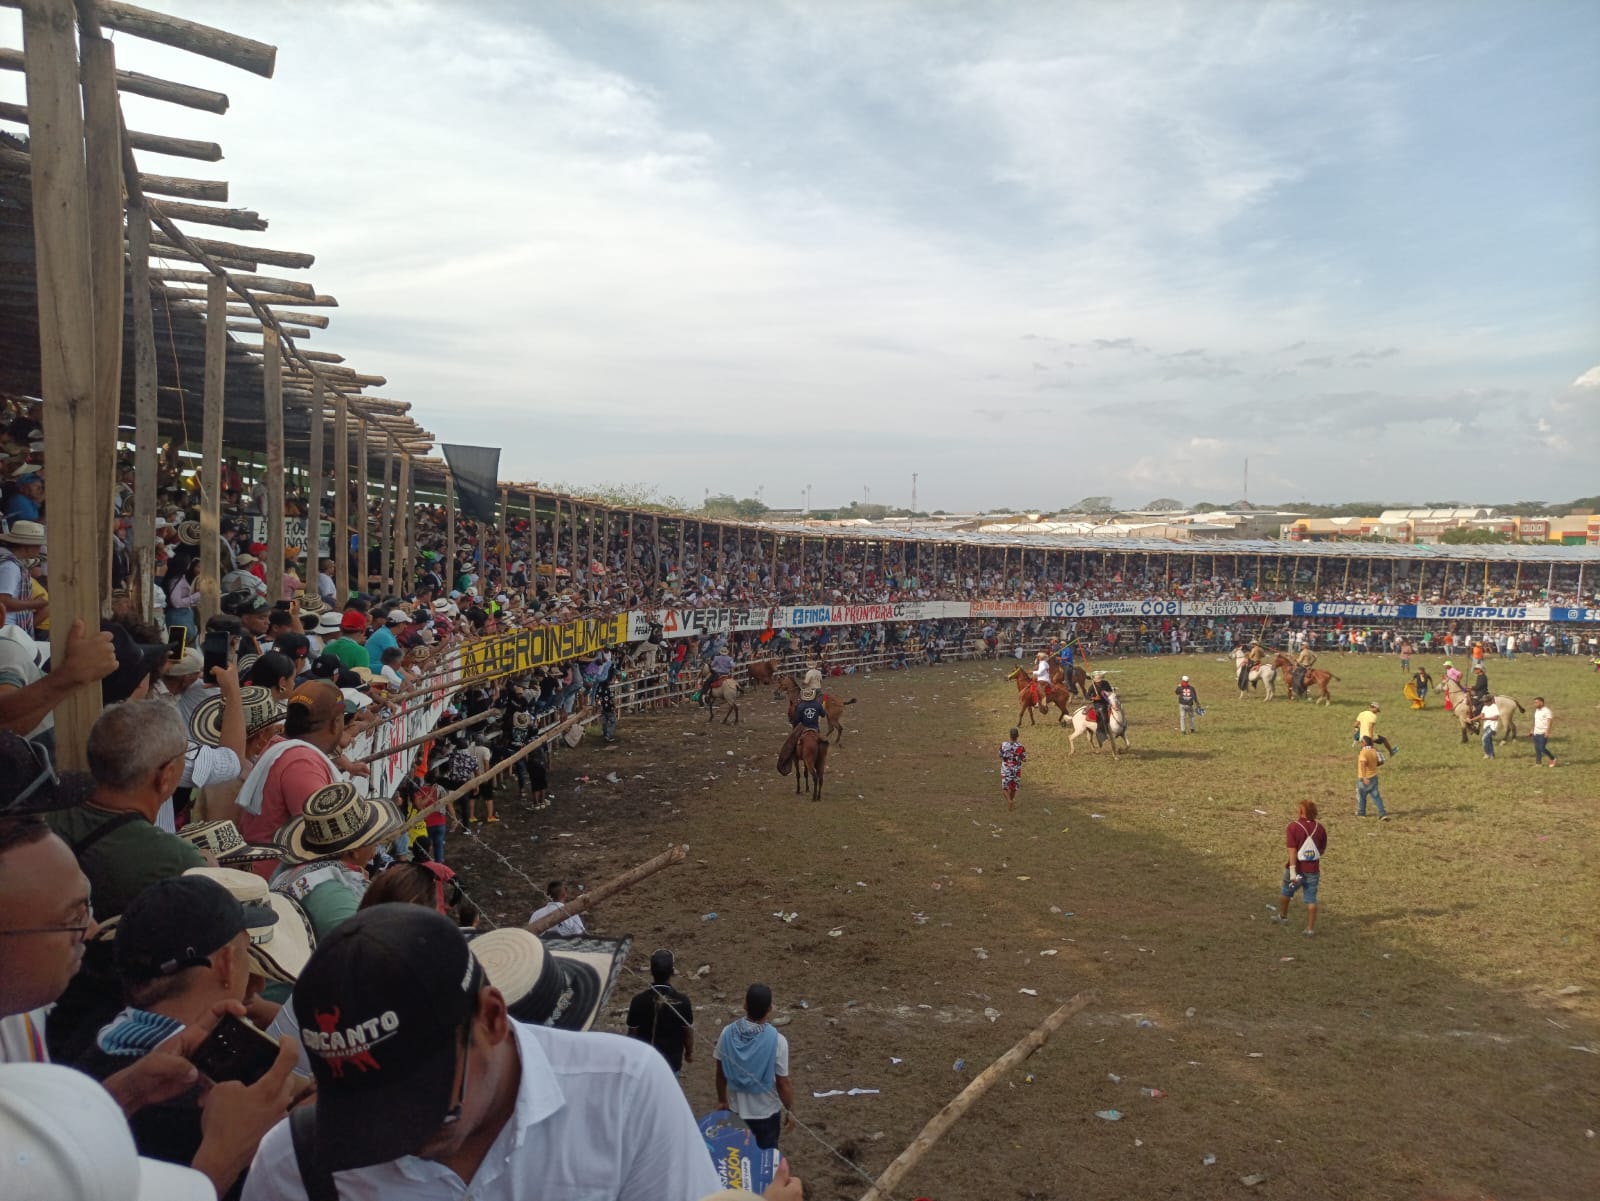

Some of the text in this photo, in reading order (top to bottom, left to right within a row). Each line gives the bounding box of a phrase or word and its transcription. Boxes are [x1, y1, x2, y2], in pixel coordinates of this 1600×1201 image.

[805, 606, 830, 624] FINCA
[832, 607, 842, 622] LA
[845, 604, 893, 623] FRONTERA
[1205, 606, 1239, 615] SIGLO
[1243, 606, 1263, 615] XXI
[1317, 603, 1399, 616] SUPERPLUS
[1439, 606, 1527, 618] SUPERPLUS
[681, 608, 750, 630] VERFER
[482, 616, 618, 675] AGROINSUMOS
